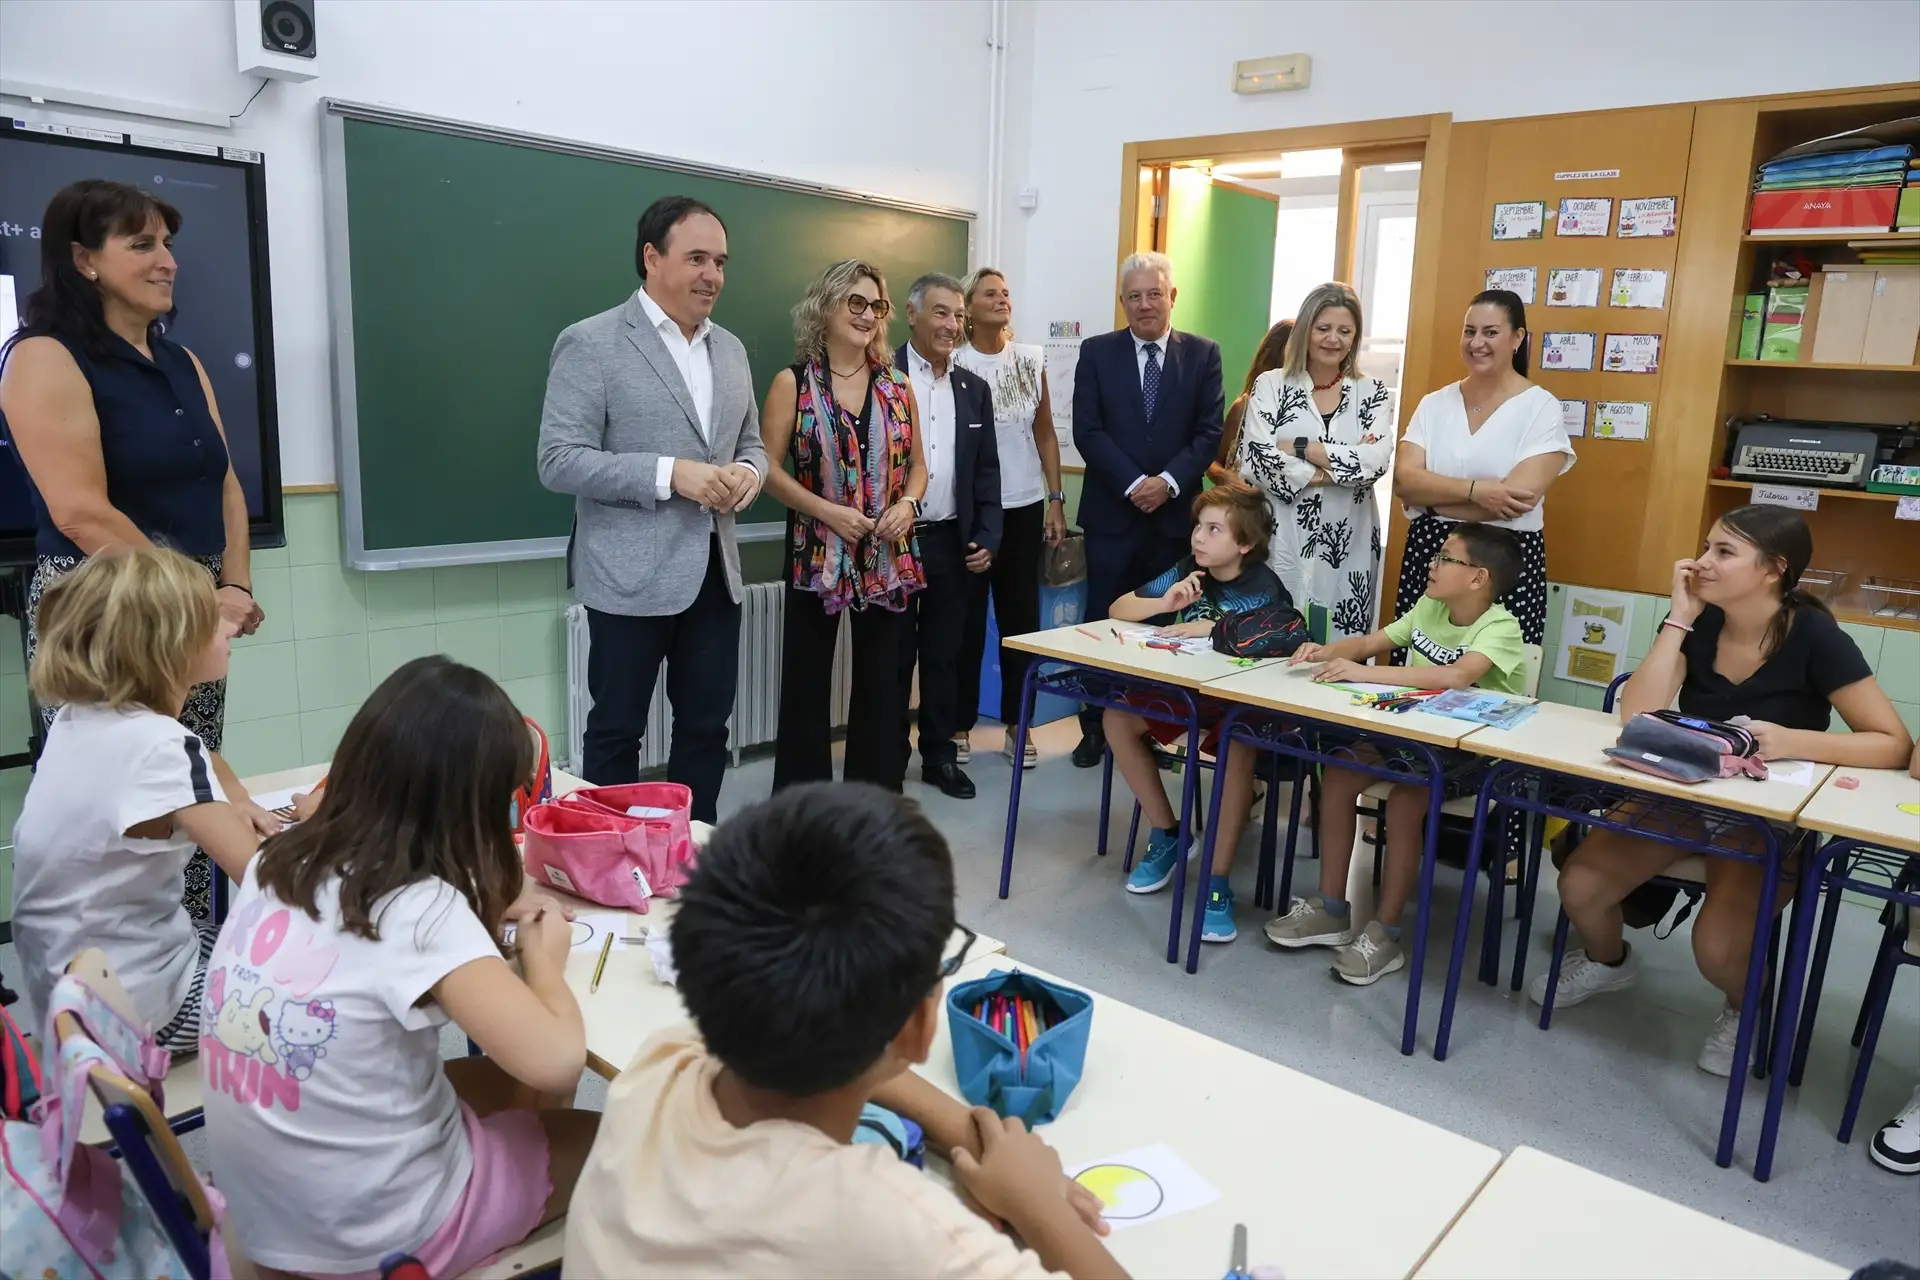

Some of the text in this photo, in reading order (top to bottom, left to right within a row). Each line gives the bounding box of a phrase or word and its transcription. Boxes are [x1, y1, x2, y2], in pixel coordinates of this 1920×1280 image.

[1503, 205, 1535, 216] SEPTIEMBRE
[1573, 201, 1598, 211] OCTUBRE
[1635, 200, 1669, 213] NOVIEMBRE
[1803, 202, 1831, 210] ANAYA
[1050, 320, 1081, 338] COMEDOR
[1560, 336, 1576, 346] ABRIL
[1633, 336, 1651, 346] MAYO
[1610, 405, 1634, 415] AGOSTO
[231, 964, 262, 985] FROM
